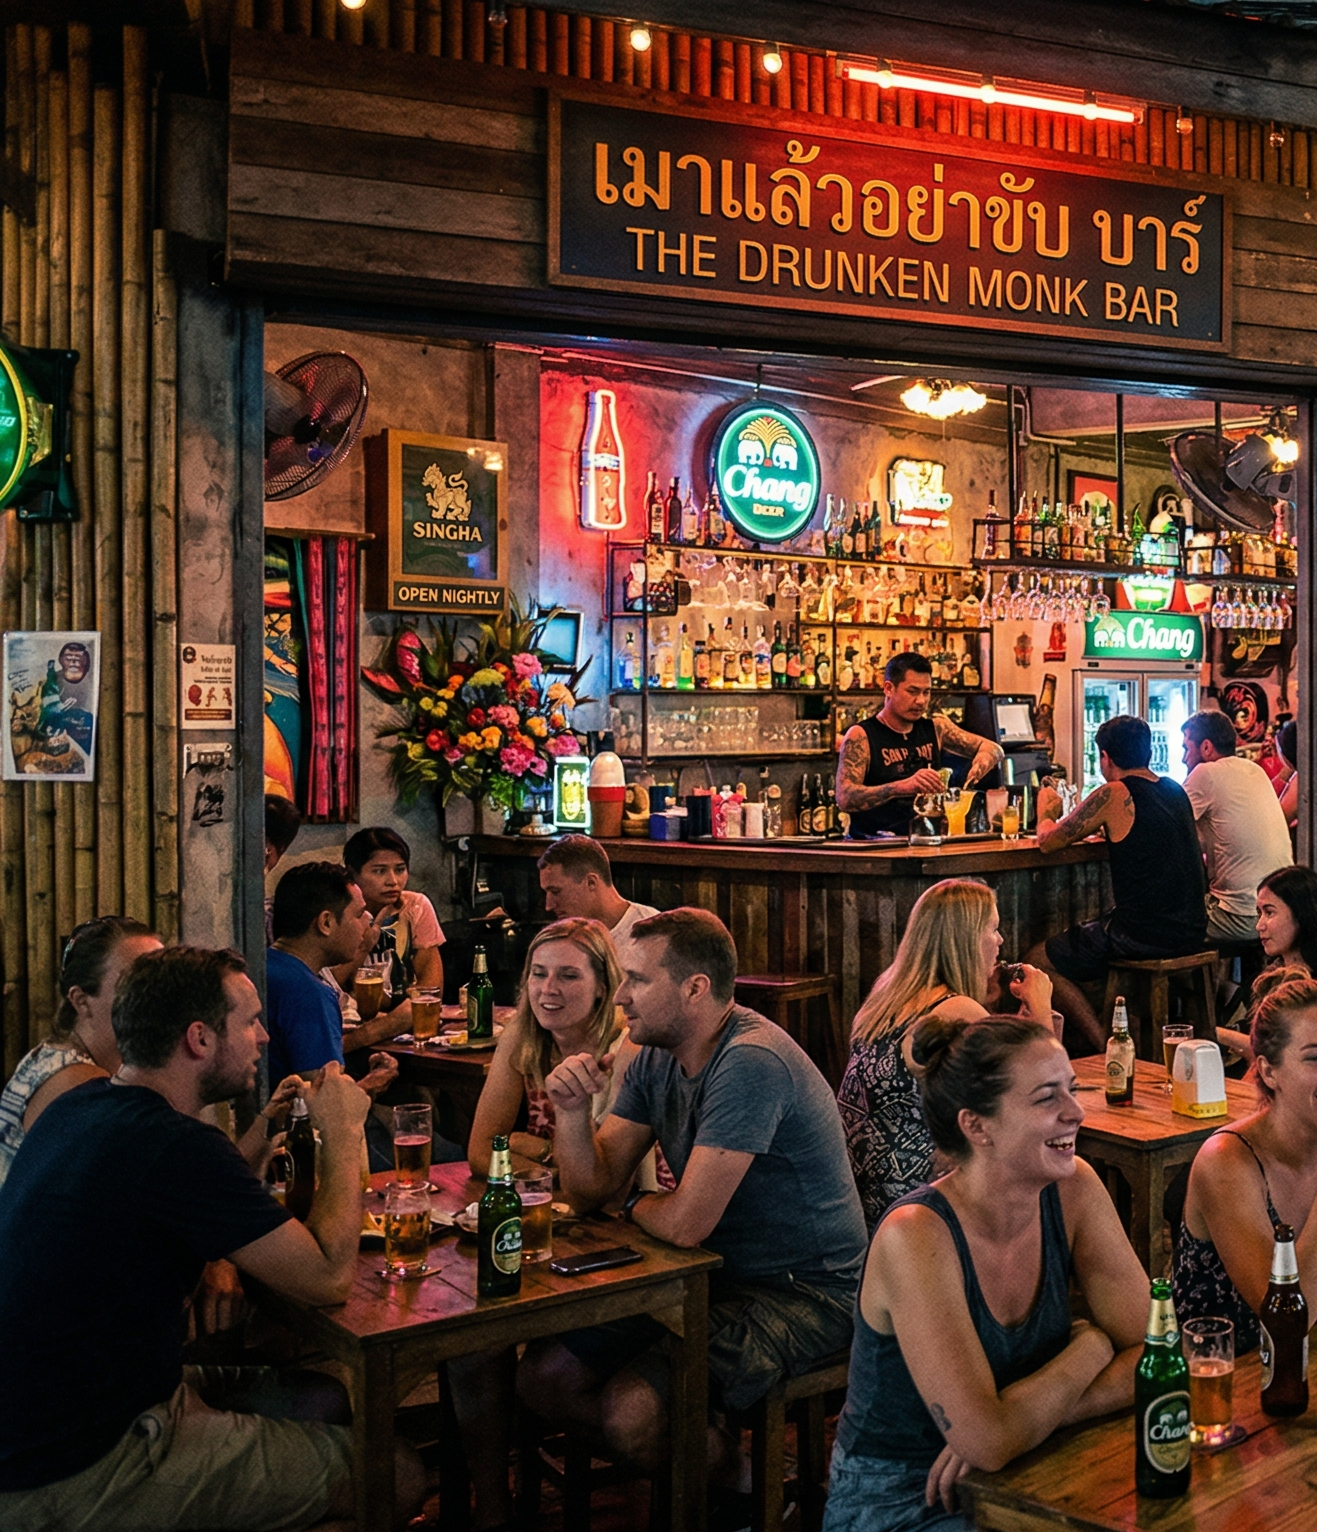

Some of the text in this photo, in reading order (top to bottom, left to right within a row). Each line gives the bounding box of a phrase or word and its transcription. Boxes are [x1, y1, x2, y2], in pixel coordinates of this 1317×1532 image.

[595, 139, 1206, 275] เมาแล้วอย่าขับ บาร์
[626, 226, 1179, 327] THE DRUNKEN MONK BAR
[723, 464, 812, 512] Chang
[412, 521, 483, 542] SINGHA
[398, 586, 500, 604] OPEN NIGHTLY
[1126, 616, 1195, 658] Chang
